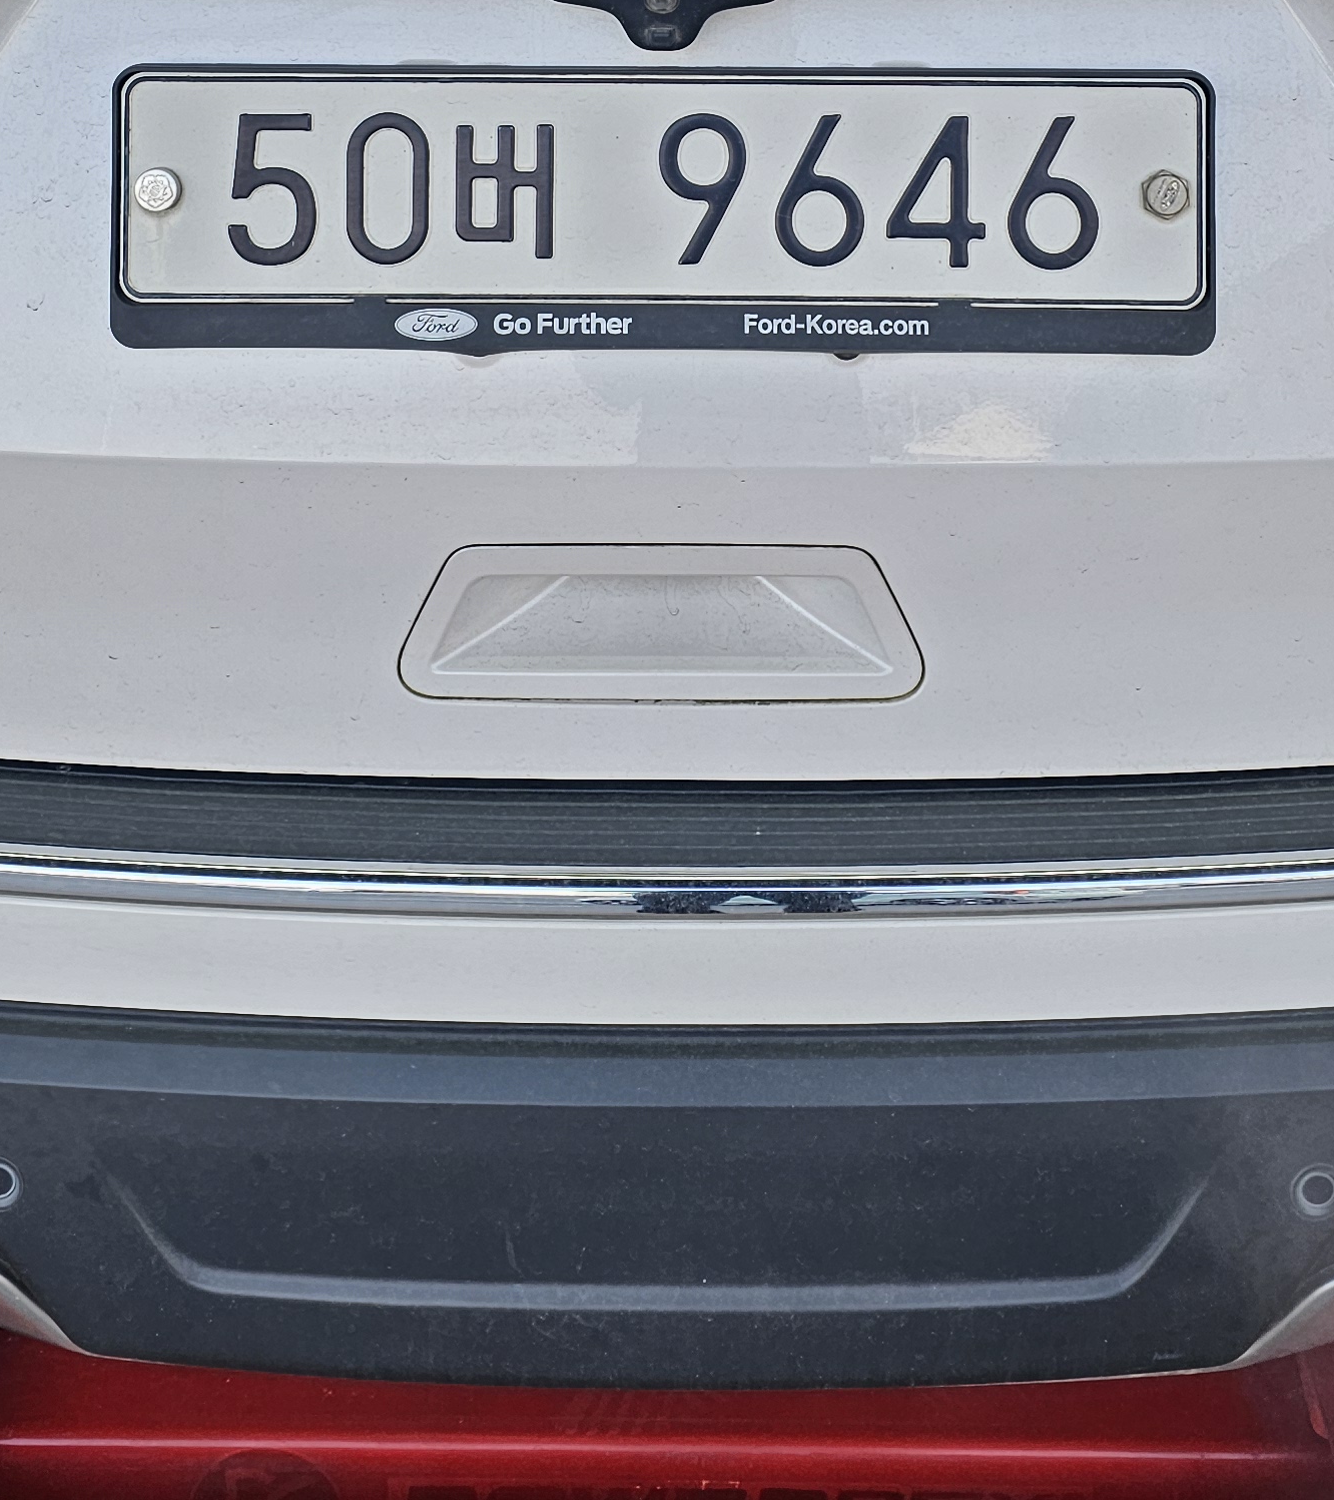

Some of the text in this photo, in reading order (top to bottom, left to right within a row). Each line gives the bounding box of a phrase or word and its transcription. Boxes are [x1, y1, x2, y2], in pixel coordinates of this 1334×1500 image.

[227, 111, 1100, 271] 50버 9646
[410, 314, 463, 337] Ford
[493, 313, 633, 336] Go Further
[743, 313, 930, 337] Ford-Korea.com
